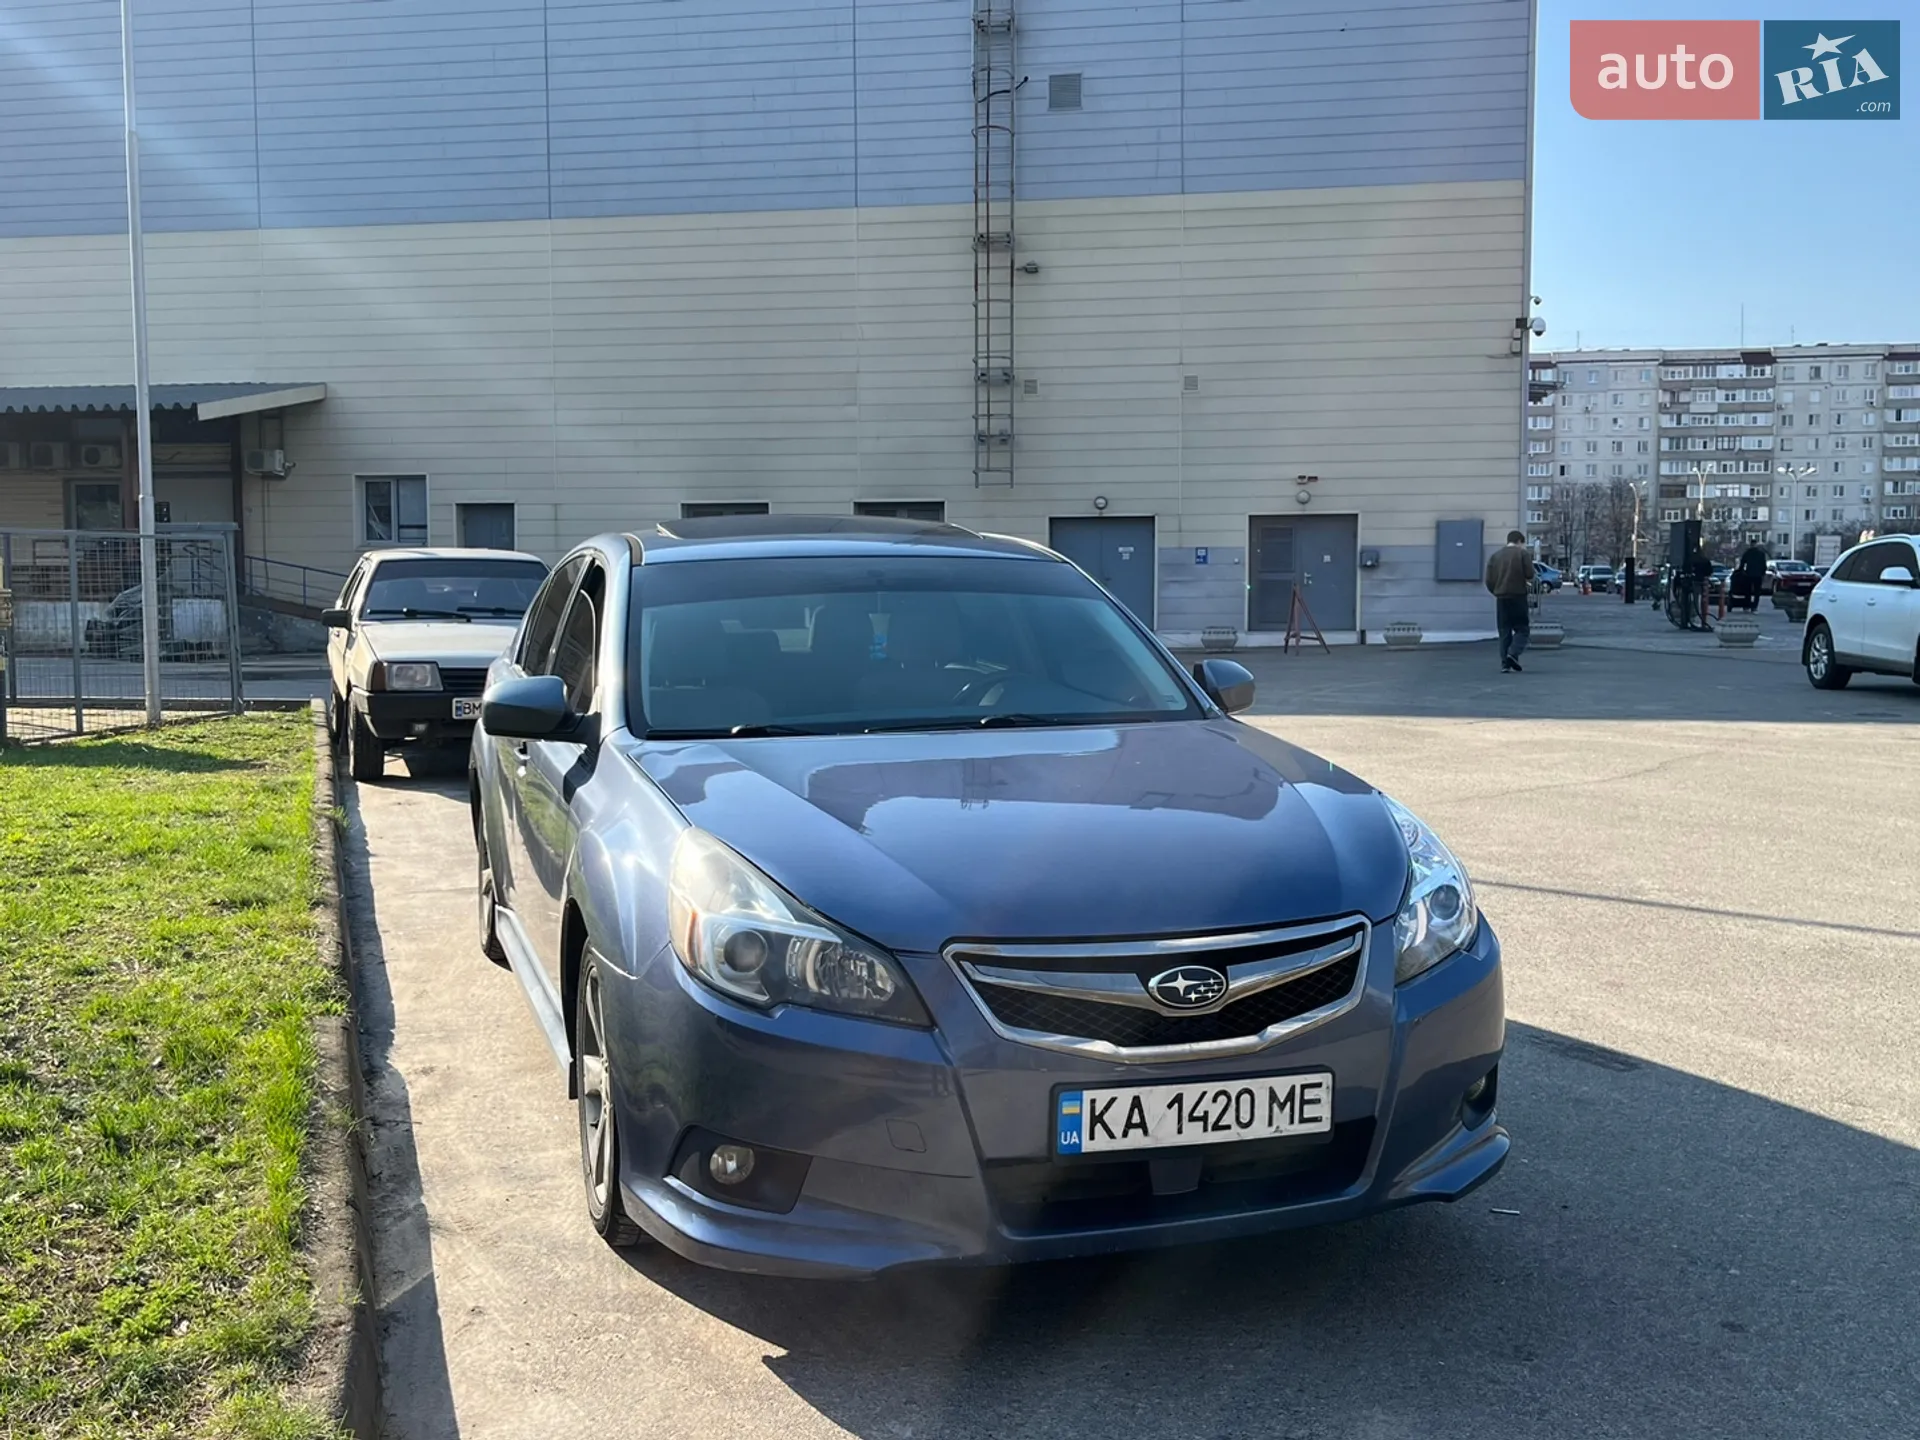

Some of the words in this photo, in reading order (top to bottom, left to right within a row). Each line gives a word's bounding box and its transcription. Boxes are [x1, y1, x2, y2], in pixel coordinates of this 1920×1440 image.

[1089, 1095, 1150, 1141] KA
[1166, 1087, 1256, 1135] 1420
[1267, 1082, 1323, 1128] ME
[1061, 1131, 1080, 1145] UA
